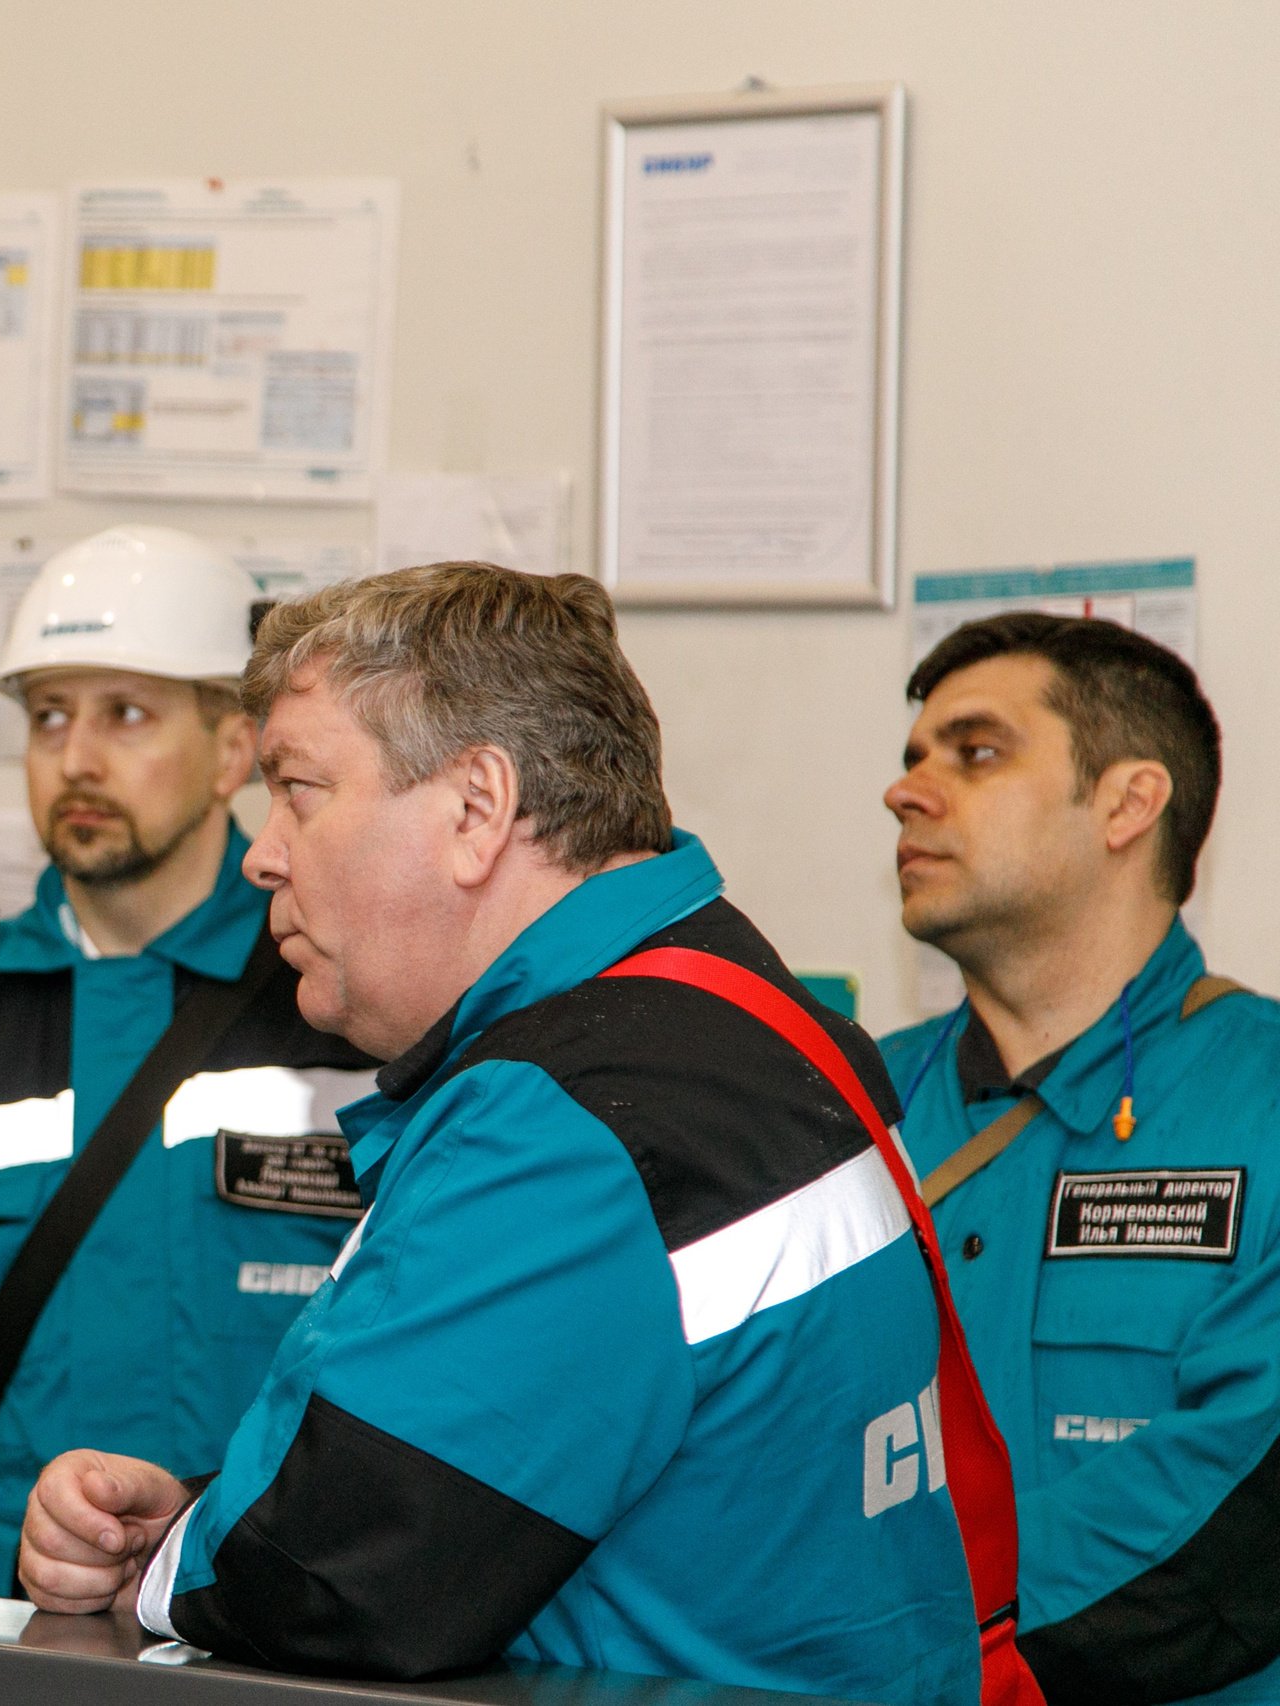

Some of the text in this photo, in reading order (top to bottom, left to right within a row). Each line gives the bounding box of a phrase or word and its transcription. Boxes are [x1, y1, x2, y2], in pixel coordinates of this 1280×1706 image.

[1064, 1180, 1232, 1199] Генеральный директор
[1079, 1202, 1208, 1223] Корженовский
[1079, 1223, 1203, 1243] Илья Иванович
[238, 1262, 332, 1296] СИБ
